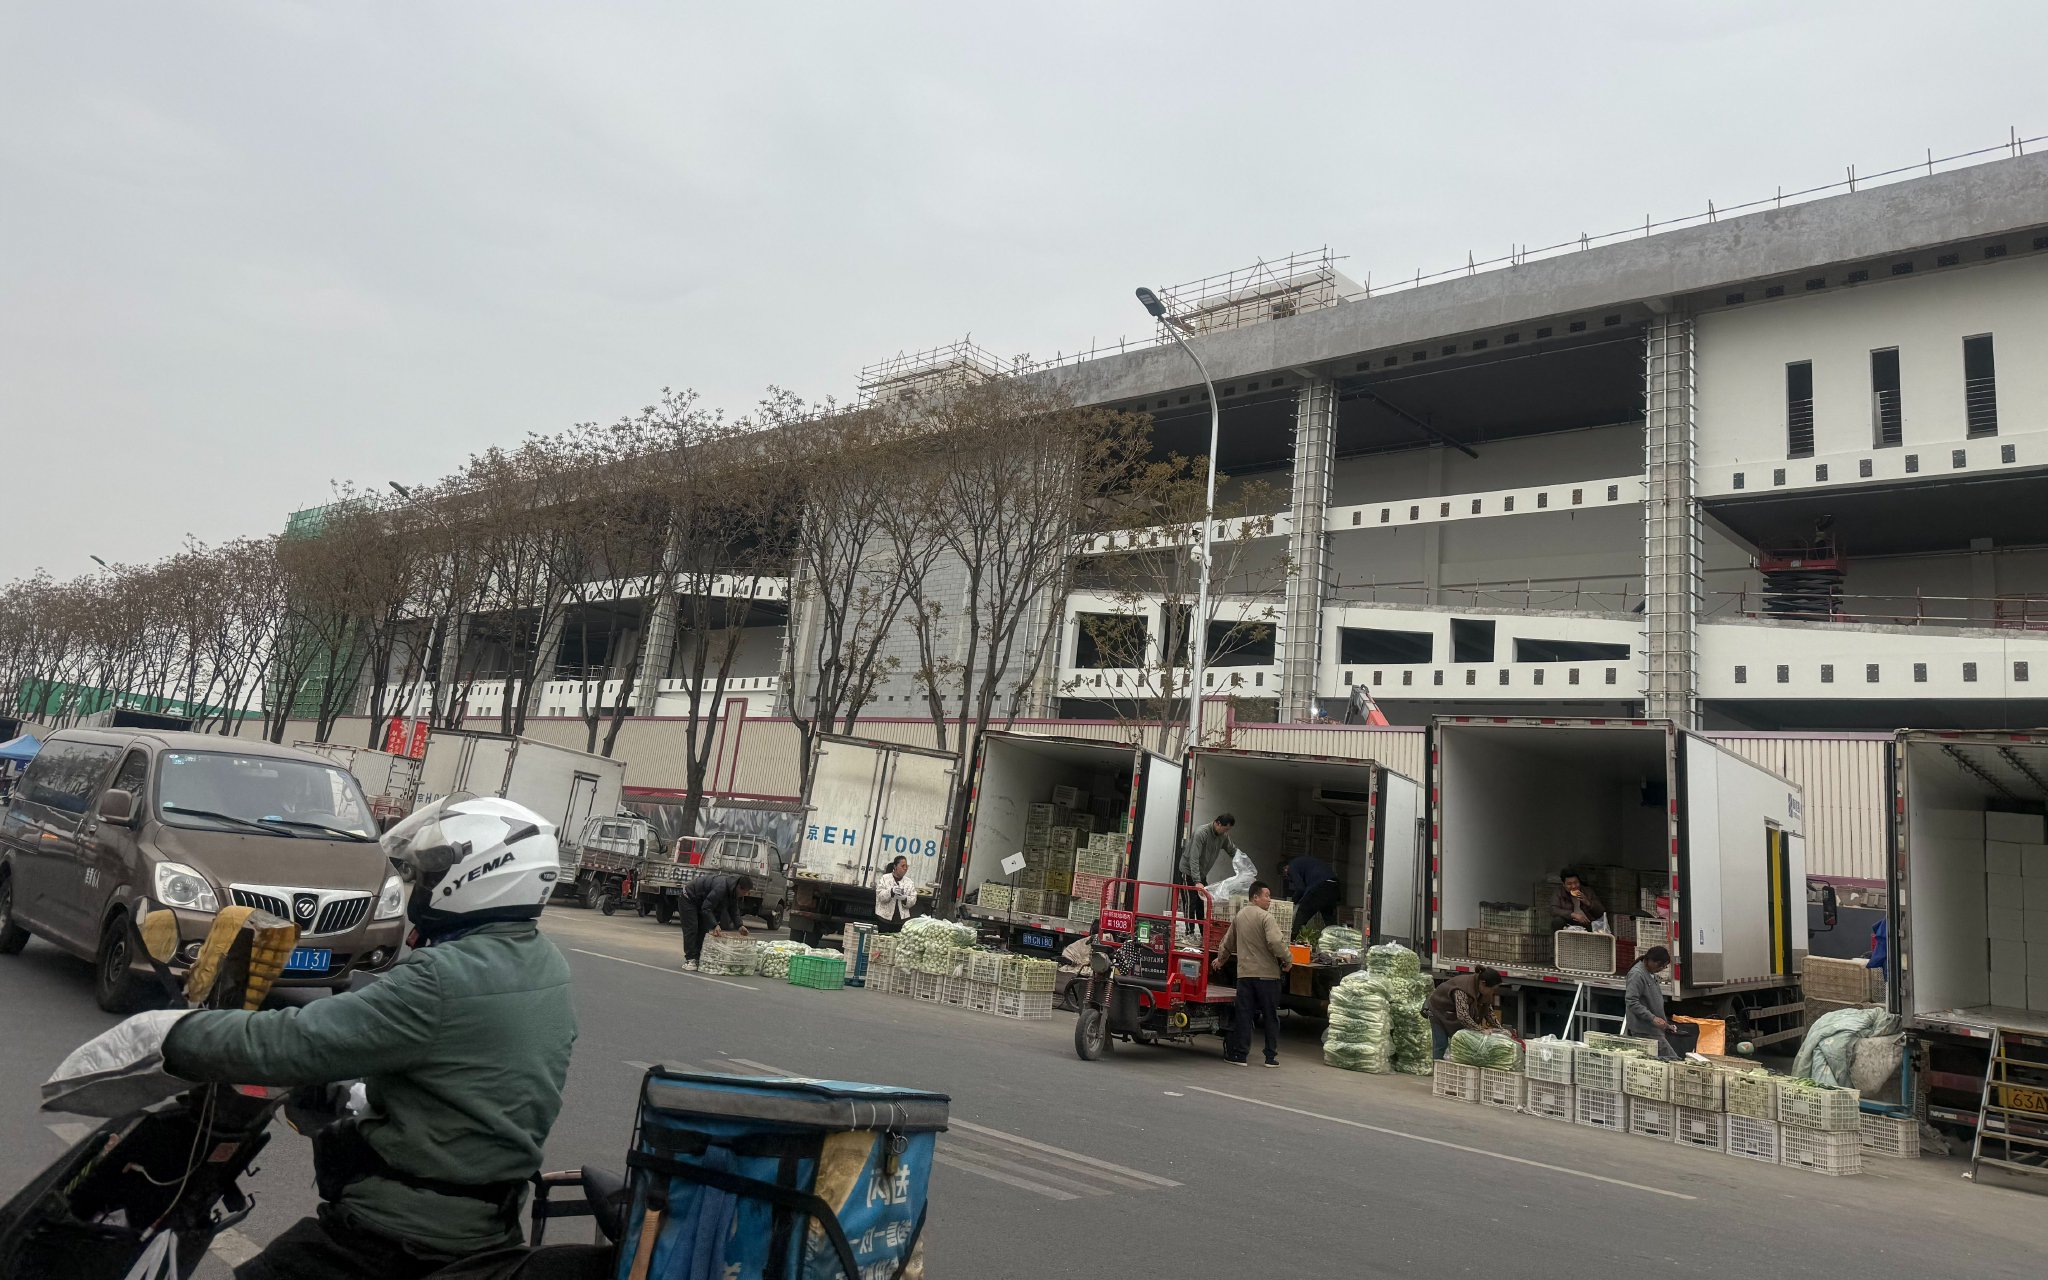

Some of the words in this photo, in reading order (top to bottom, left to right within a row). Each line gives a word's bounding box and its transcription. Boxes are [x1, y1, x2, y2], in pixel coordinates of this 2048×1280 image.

[806, 824, 857, 847] 京EH
[881, 833, 937, 858] T008
[453, 852, 516, 889] YEMA
